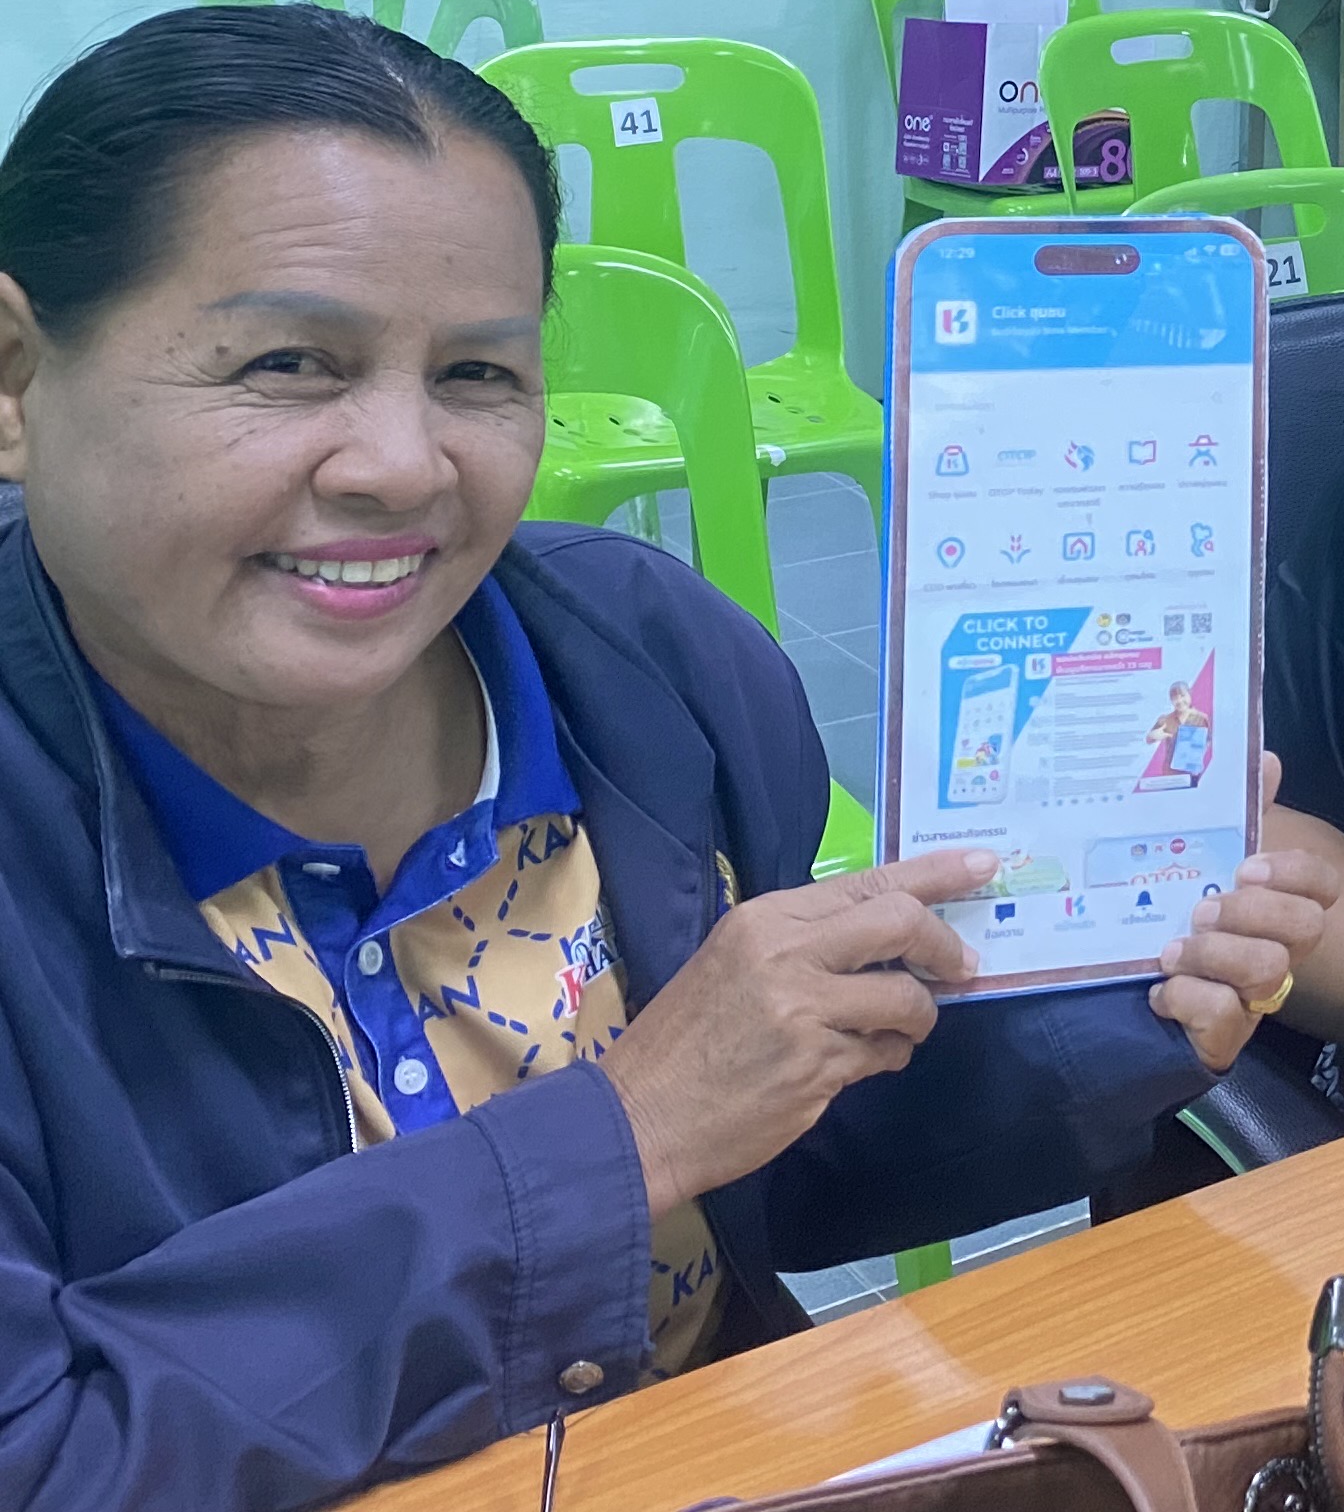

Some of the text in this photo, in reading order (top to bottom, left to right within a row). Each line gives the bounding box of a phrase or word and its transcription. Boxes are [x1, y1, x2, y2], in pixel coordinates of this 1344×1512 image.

[999, 80, 1039, 104] on
[620, 109, 658, 135] 41
[904, 114, 931, 132] one
[1266, 256, 1301, 287] 21
[992, 306, 1026, 319] Click
[963, 615, 1048, 634] CLICK TO
[977, 632, 1068, 651] CONNECT
